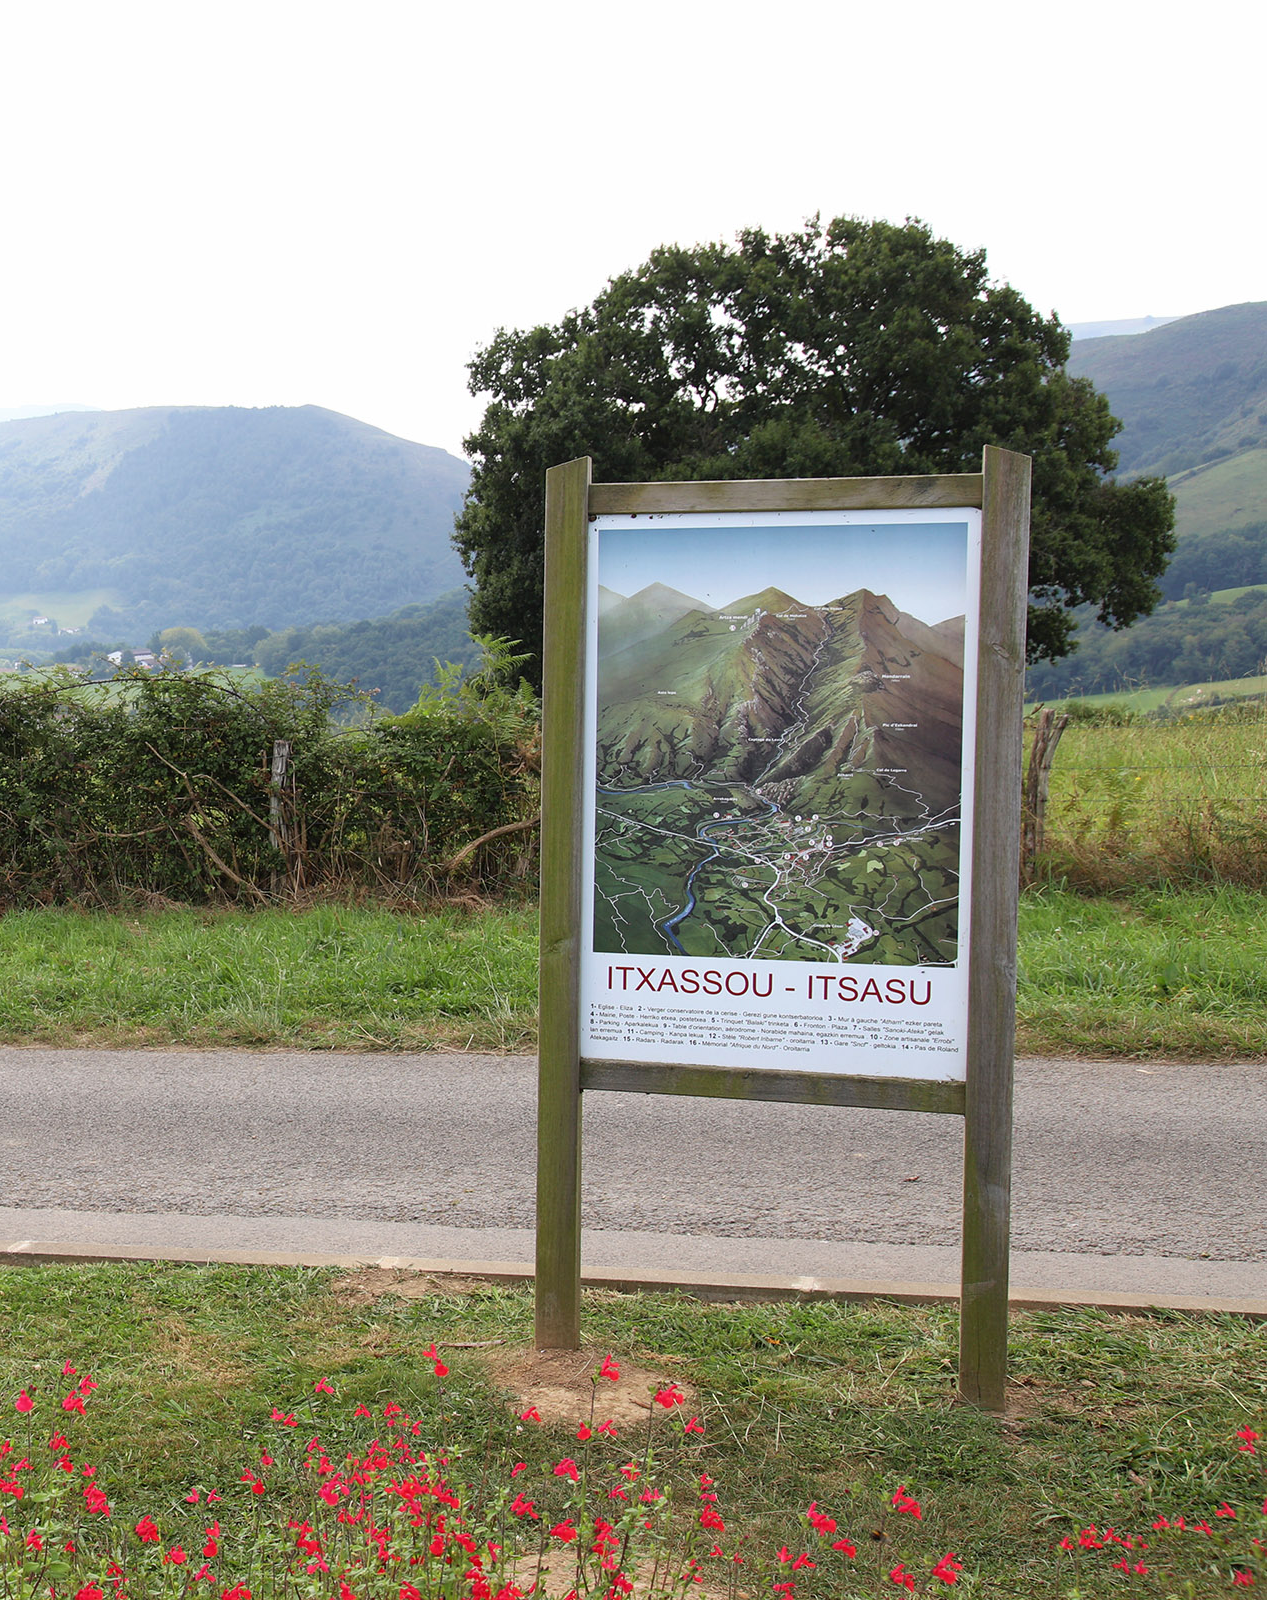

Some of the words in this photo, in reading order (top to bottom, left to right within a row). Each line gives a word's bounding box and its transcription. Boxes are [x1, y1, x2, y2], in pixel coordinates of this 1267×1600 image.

[608, 966, 773, 997] ITXASSOU
[808, 974, 932, 1005] ITSASU
[598, 1003, 614, 1011] Eglise
[647, 1005, 665, 1014] Verger
[667, 1006, 704, 1015] conservatoire
[856, 1016, 878, 1025] gauche
[923, 1020, 942, 1029] pareta
[721, 1017, 743, 1026] Trinquet
[599, 1018, 620, 1027] Parking
[672, 1022, 687, 1030] Table
[725, 1025, 756, 1033] aérodrome
[901, 1035, 930, 1043] artisanale
[639, 1028, 664, 1038] Camping
[738, 1034, 759, 1042] "Robert
[636, 1036, 655, 1044] Radars
[730, 1042, 751, 1050] "Afrique
